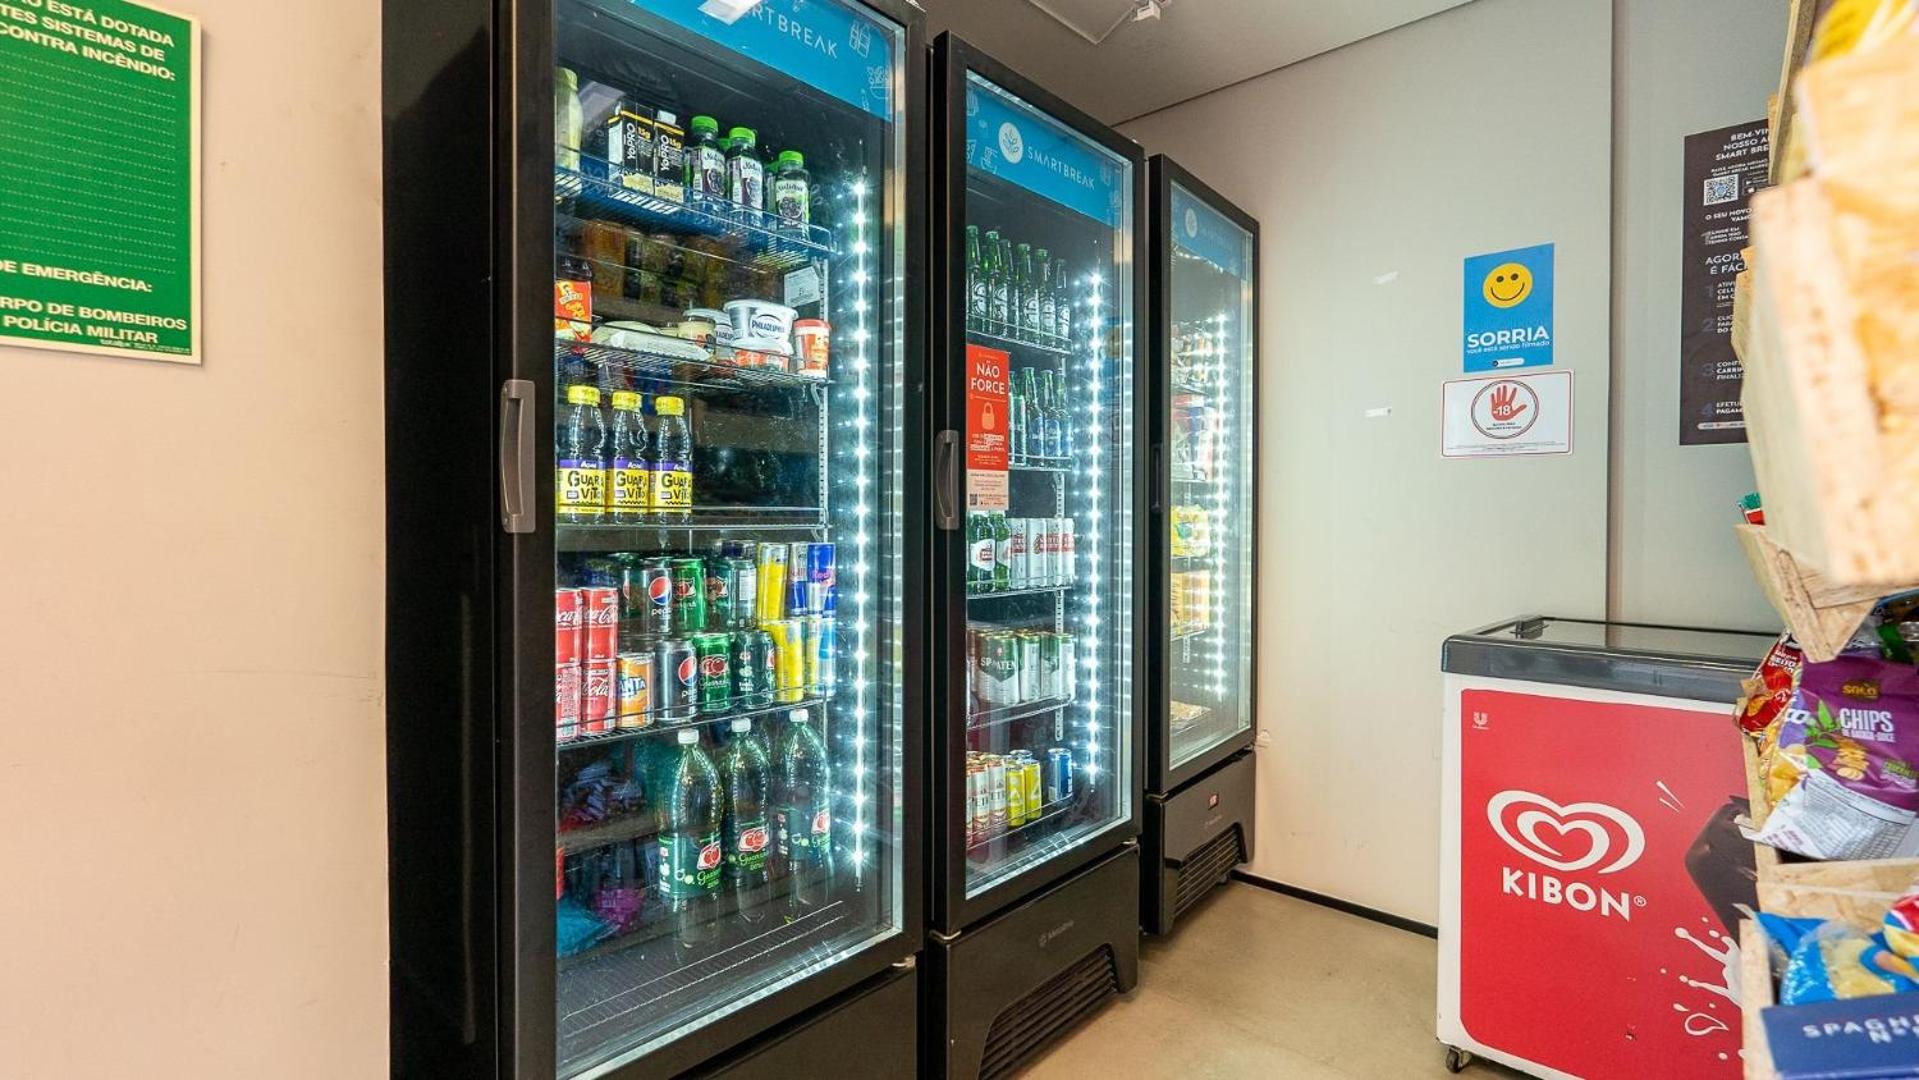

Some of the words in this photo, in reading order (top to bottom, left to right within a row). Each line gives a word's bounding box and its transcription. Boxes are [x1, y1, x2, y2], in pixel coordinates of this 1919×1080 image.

[46, 0, 97, 25] ESTÁ
[100, 15, 175, 47] DOTADA
[749, 5, 838, 59] RTBREAK
[41, 16, 136, 53] SISTEMAS
[139, 43, 165, 62] DE
[82, 45, 176, 81] INCÊNDIO:
[1715, 148, 1748, 160] SMART
[1723, 138, 1758, 151] NOSSO
[1027, 146, 1095, 190] SMARTBREAK
[1713, 211, 1728, 219] SEU
[22, 262, 153, 293] EMERGÊNCIA:
[1711, 265, 1718, 275] É
[3, 314, 82, 336] POLÍCIA
[87, 324, 158, 344] MILITAR
[47, 302, 75, 317] DE
[79, 306, 188, 331] BOMBEIROS
[1466, 325, 1550, 348] SORRIA
[1522, 339, 1550, 349] filmado
[976, 359, 1000, 378] NÃO
[970, 377, 1006, 395] FORCE
[1840, 707, 1894, 733] CHIPS
